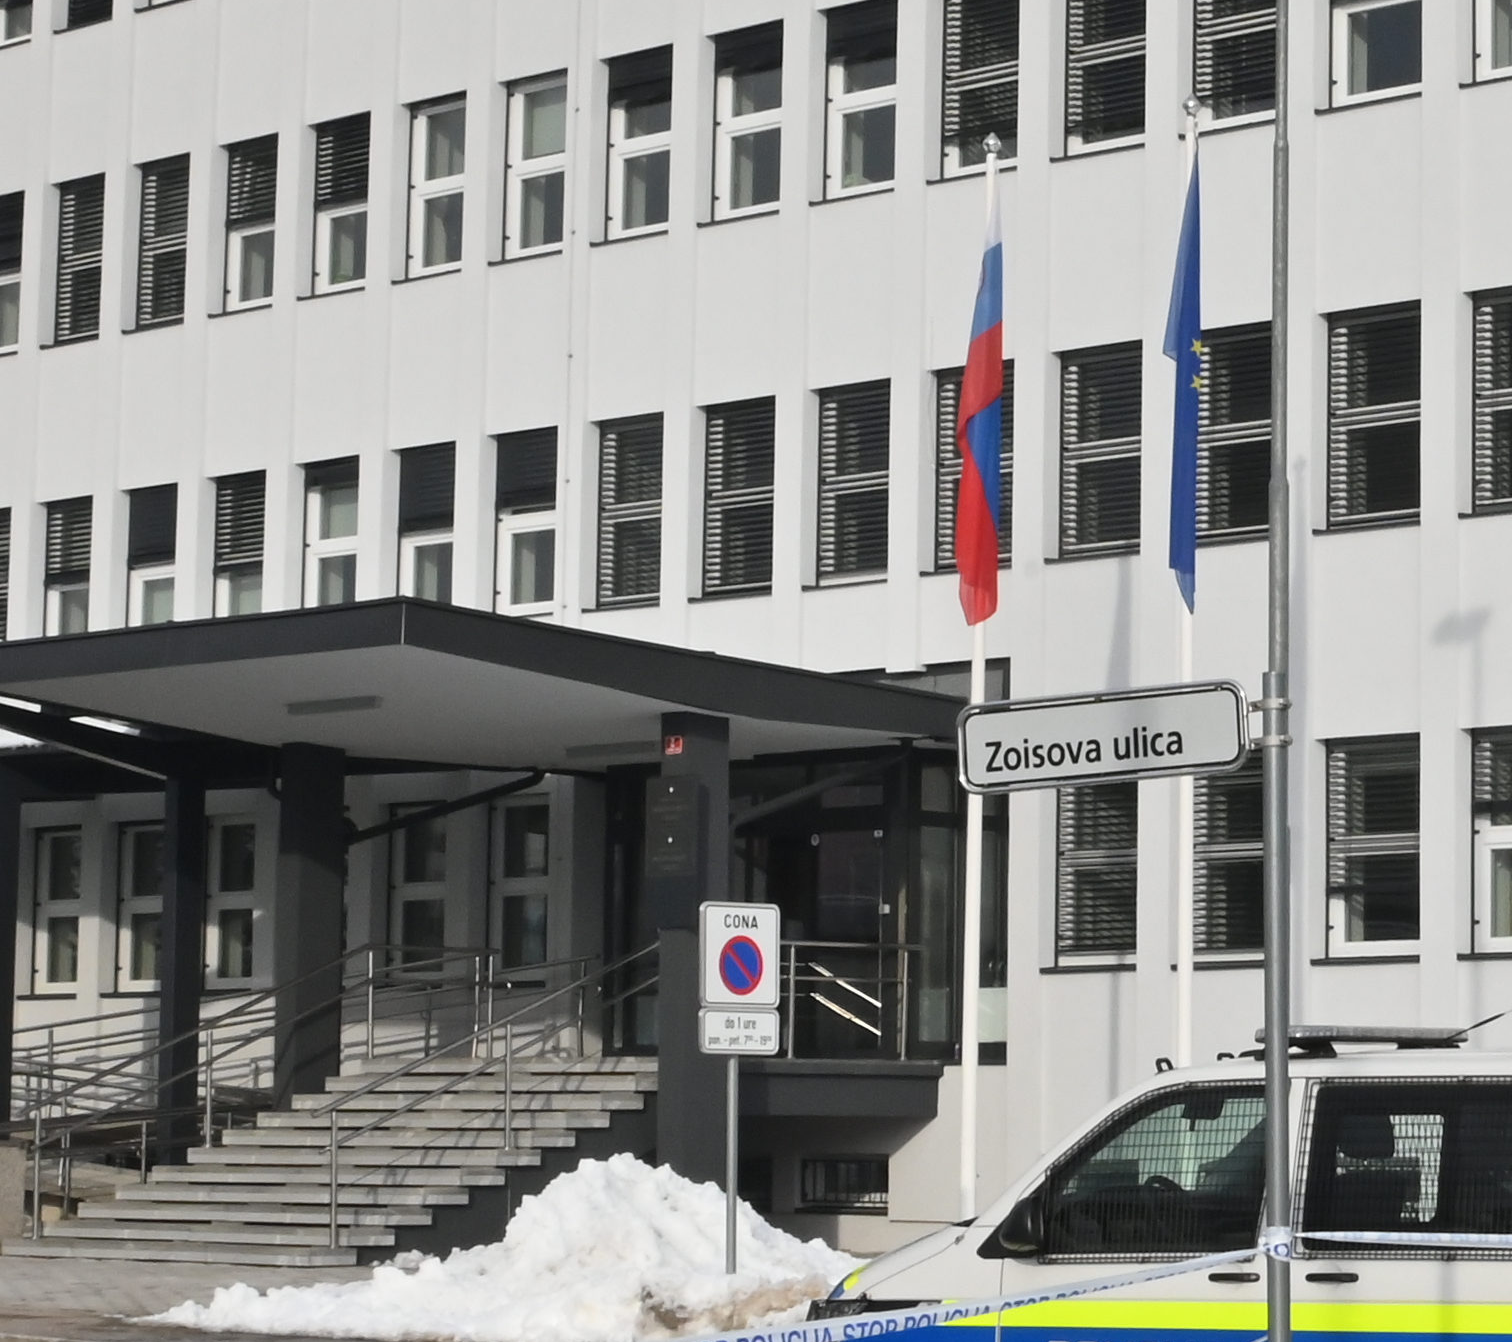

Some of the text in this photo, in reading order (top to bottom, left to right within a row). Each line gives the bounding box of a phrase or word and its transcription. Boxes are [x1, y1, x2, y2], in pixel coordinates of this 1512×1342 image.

[985, 726, 1184, 773] Zoisova ulica
[724, 914, 758, 929] CONA
[725, 1016, 735, 1029] do
[743, 1020, 756, 1029] ure
